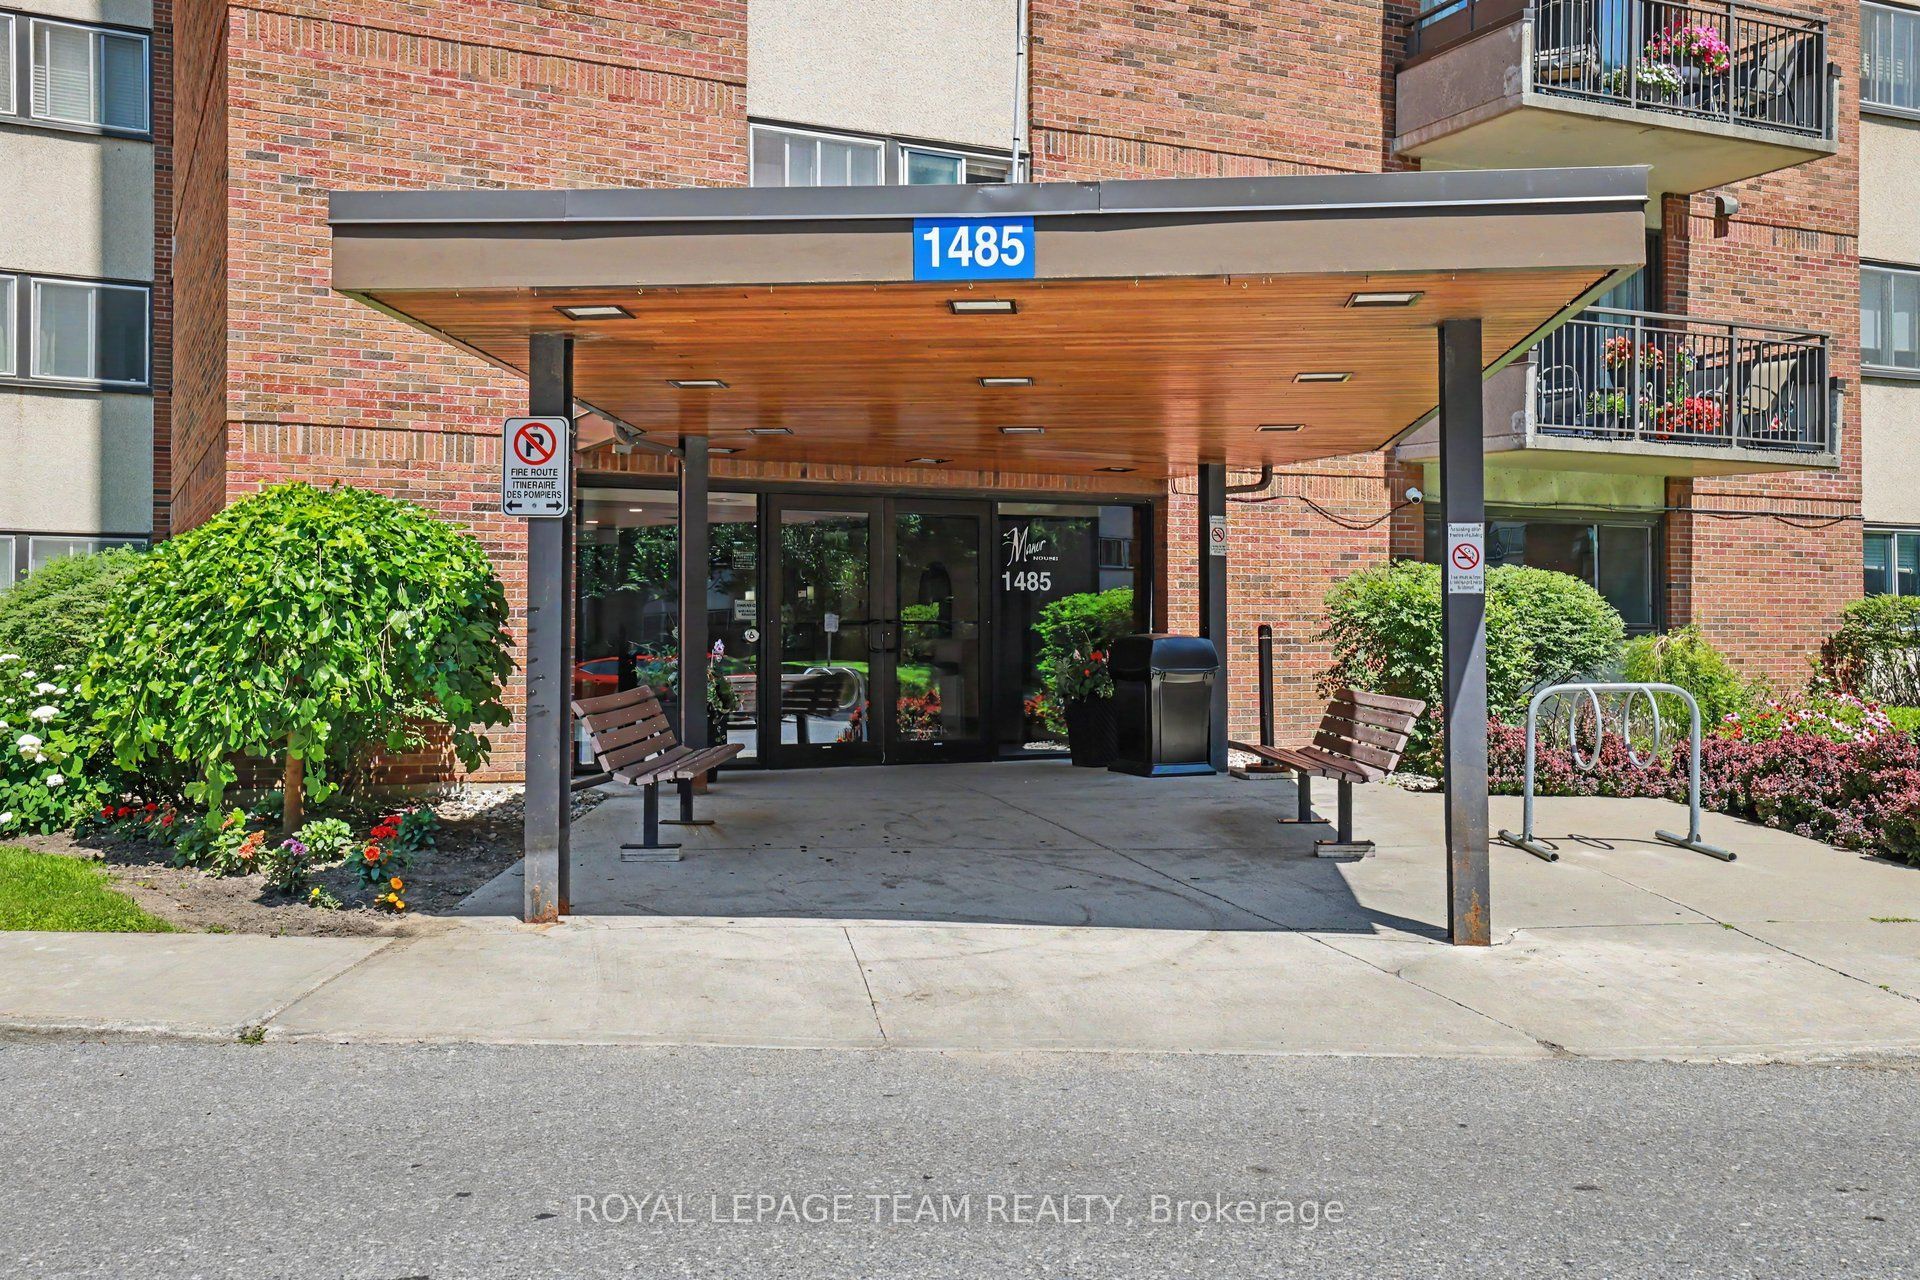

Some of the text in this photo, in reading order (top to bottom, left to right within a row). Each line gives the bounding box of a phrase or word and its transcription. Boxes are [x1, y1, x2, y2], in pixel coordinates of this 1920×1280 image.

[923, 225, 1025, 268] 1485
[511, 468, 558, 476] FIRE ROUTE
[512, 481, 556, 489] ITINERAIRE
[506, 490, 562, 499] DES POMPIERS
[1001, 571, 1052, 592] 1485
